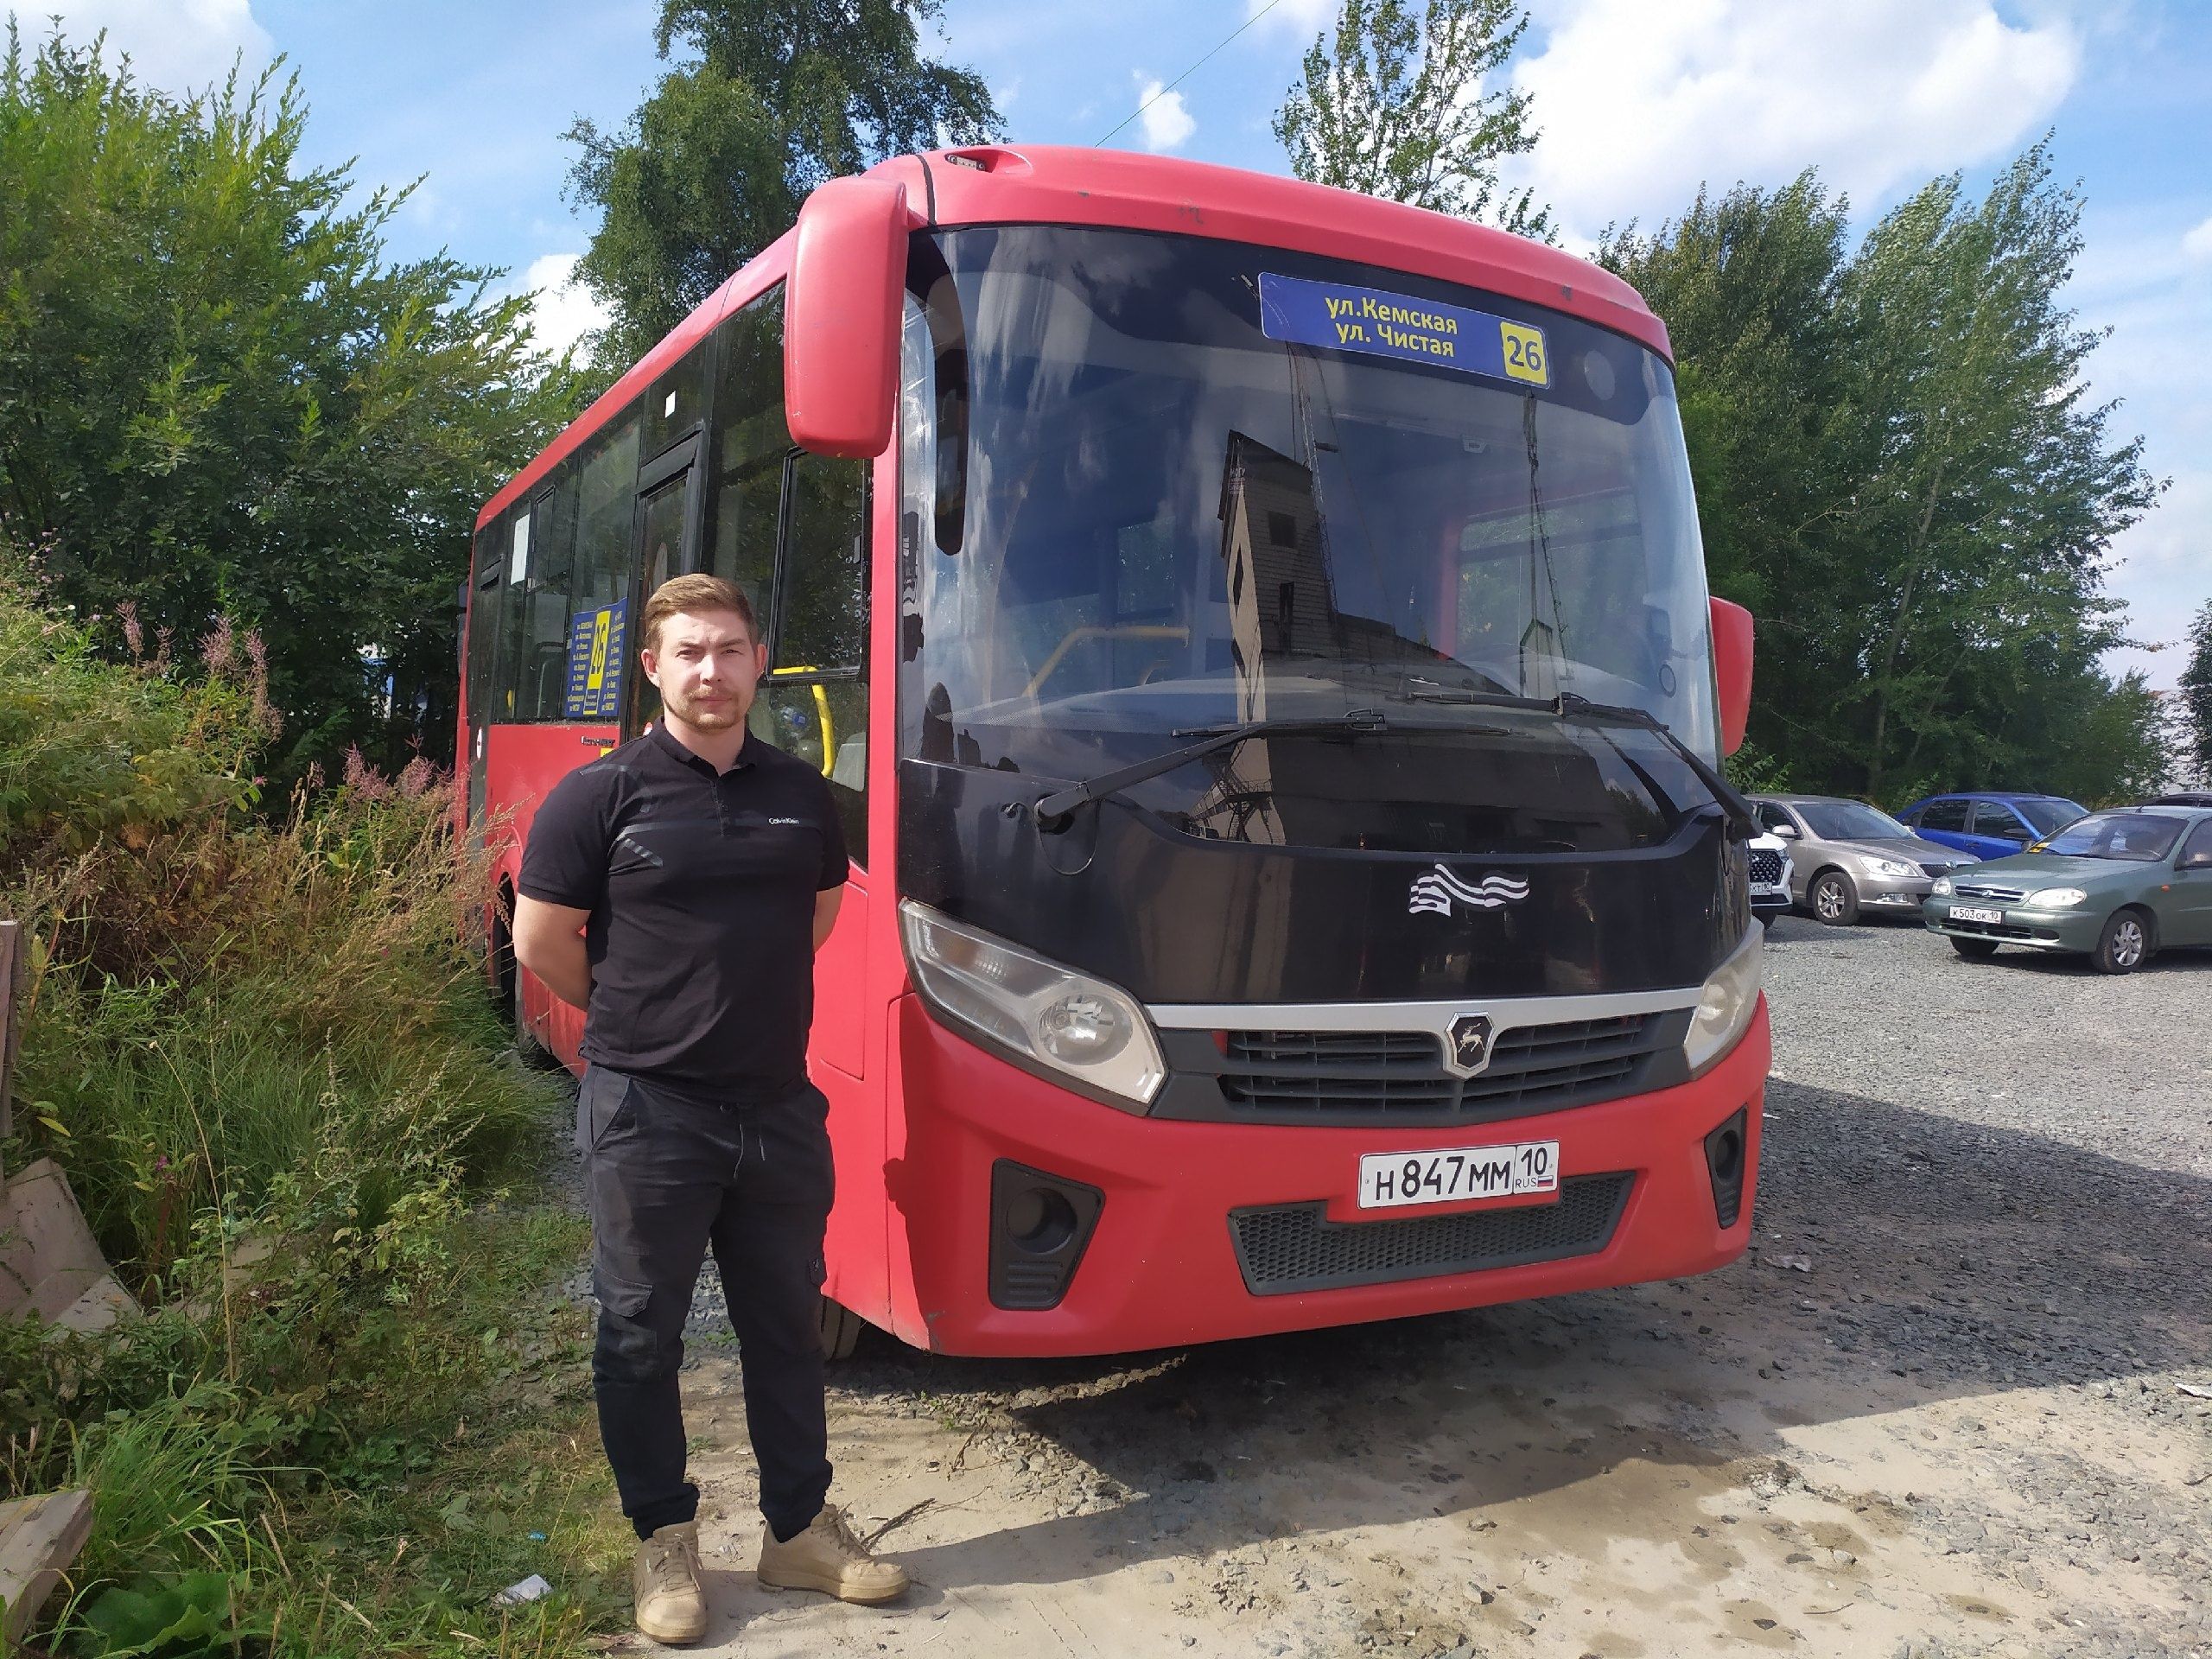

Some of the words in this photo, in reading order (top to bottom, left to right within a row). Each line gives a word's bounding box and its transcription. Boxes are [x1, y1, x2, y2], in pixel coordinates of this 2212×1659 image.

[1325, 296, 1459, 335] ул.Кемская
[1335, 321, 1372, 344] ул.
[1376, 322, 1455, 358] Чистая
[1506, 334, 1542, 372] 26
[590, 622, 607, 674] 26
[1375, 1155, 1510, 1201] Н847ММ
[1520, 1147, 1548, 1176] 10
[1515, 1177, 1537, 1189] RUS
